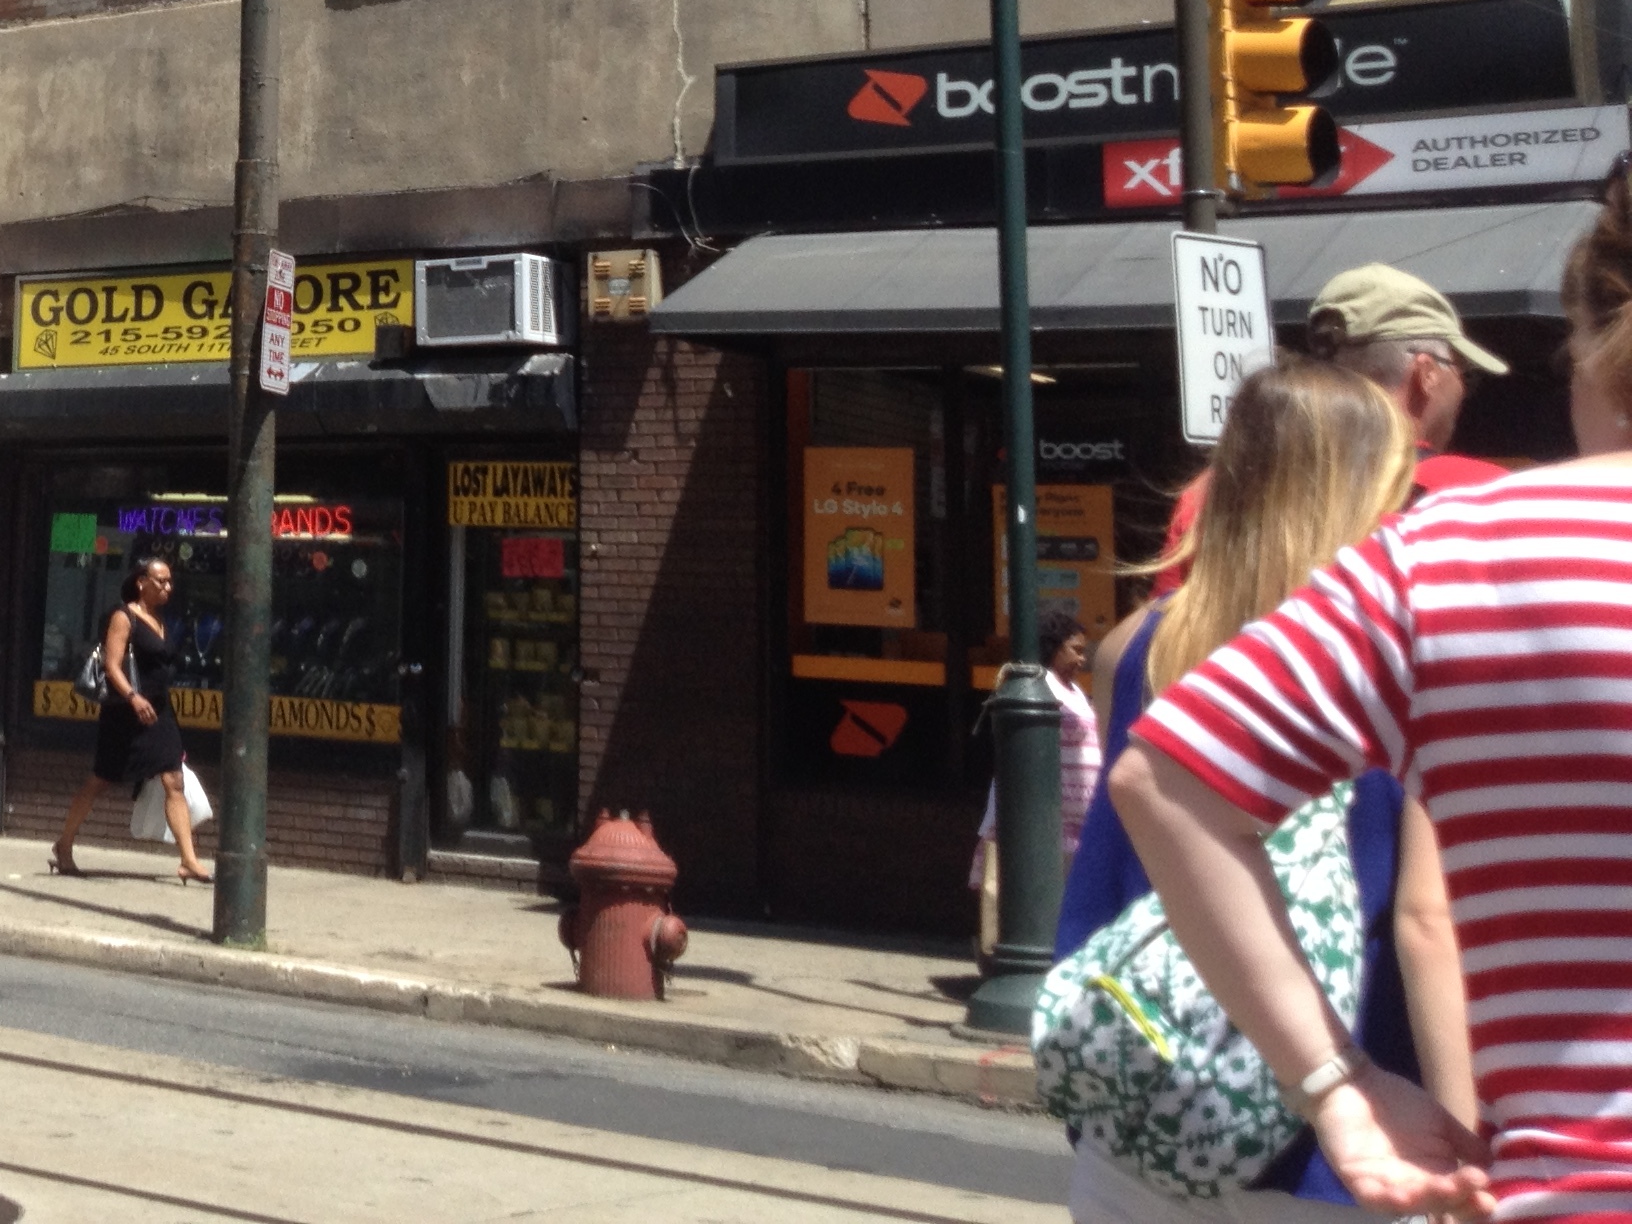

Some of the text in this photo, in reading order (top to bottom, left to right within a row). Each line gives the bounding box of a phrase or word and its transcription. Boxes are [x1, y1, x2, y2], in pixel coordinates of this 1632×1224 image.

[1412, 126, 1601, 153] AUTHORIZED
[1412, 151, 1528, 173] DEALER
[1200, 255, 1242, 295] NO
[31, 283, 165, 327] GOLD
[273, 294, 285, 310] NO
[1198, 306, 1253, 339] TURN
[99, 345, 120, 356] 45
[124, 343, 188, 356] SOUTH
[269, 332, 285, 347] ANY
[268, 349, 285, 364] TIME
[1213, 351, 1243, 381] ON
[1039, 439, 1125, 460] boost
[452, 464, 579, 498] LOST LAYAWAYS
[846, 481, 887, 496] Free
[467, 501, 499, 524] PAY
[502, 501, 576, 525] BALANCE
[813, 498, 904, 519] LG Stylo 4
